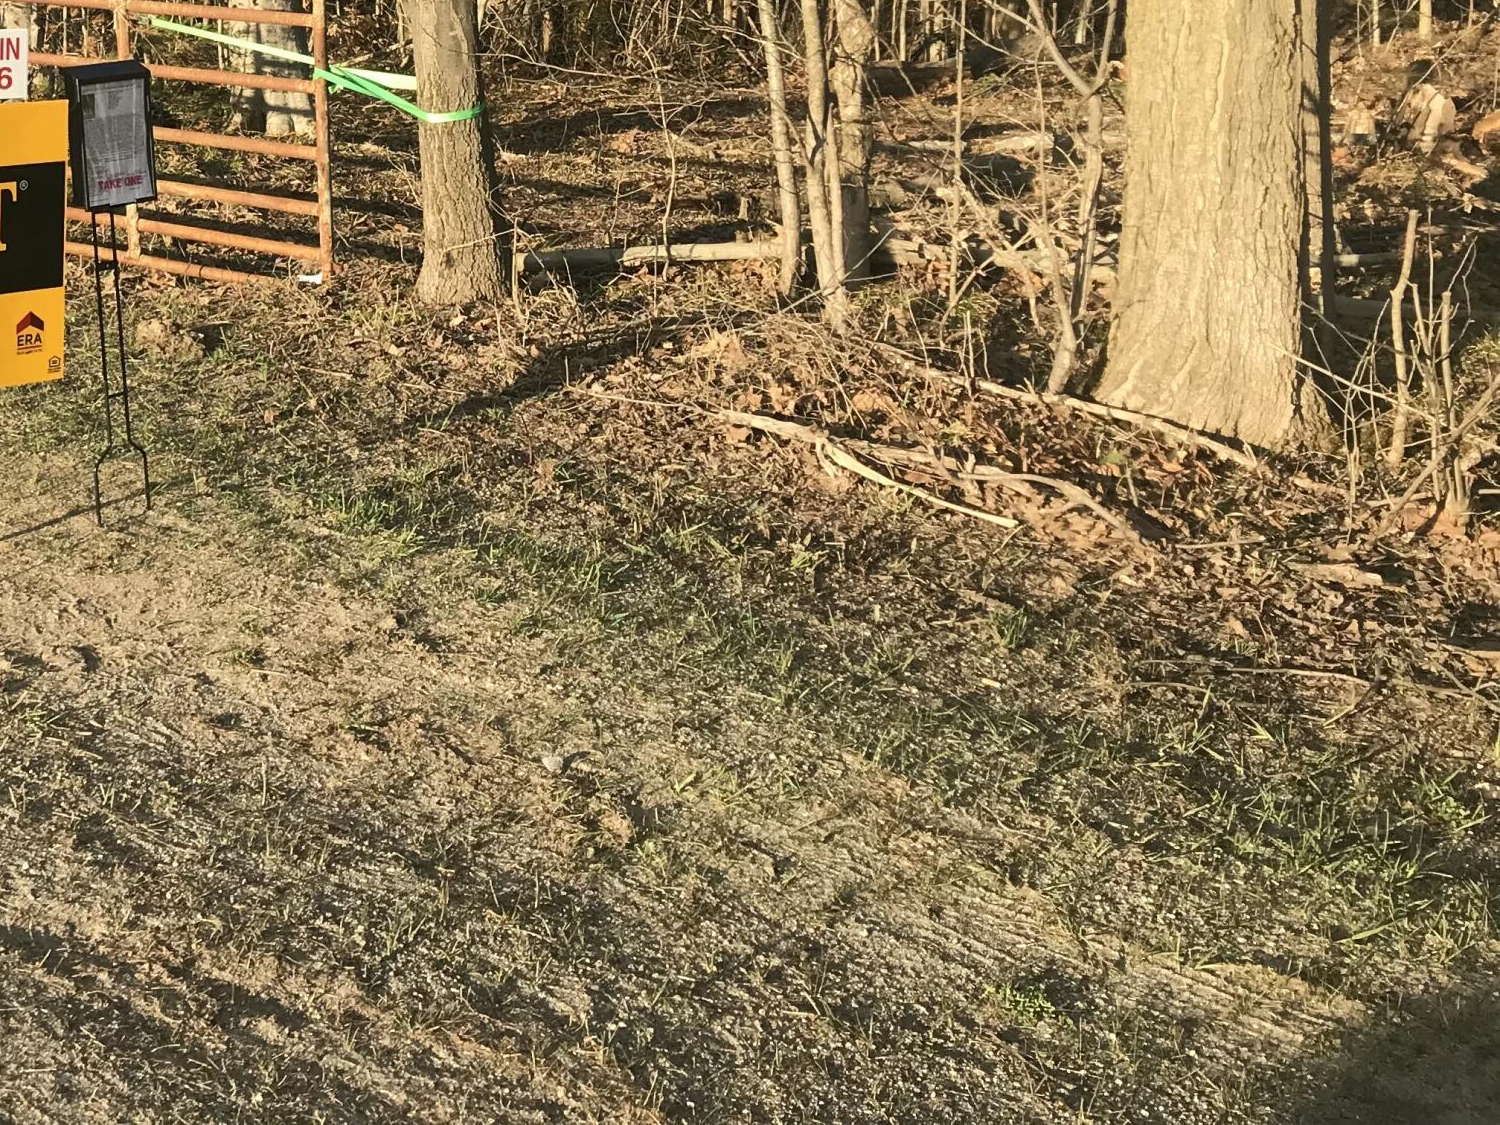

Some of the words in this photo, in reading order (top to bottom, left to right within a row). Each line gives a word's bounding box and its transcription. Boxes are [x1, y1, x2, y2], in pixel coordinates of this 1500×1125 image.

[98, 177, 122, 191] TAKE
[123, 175, 143, 187] ONE
[16, 332, 43, 347] ERA
